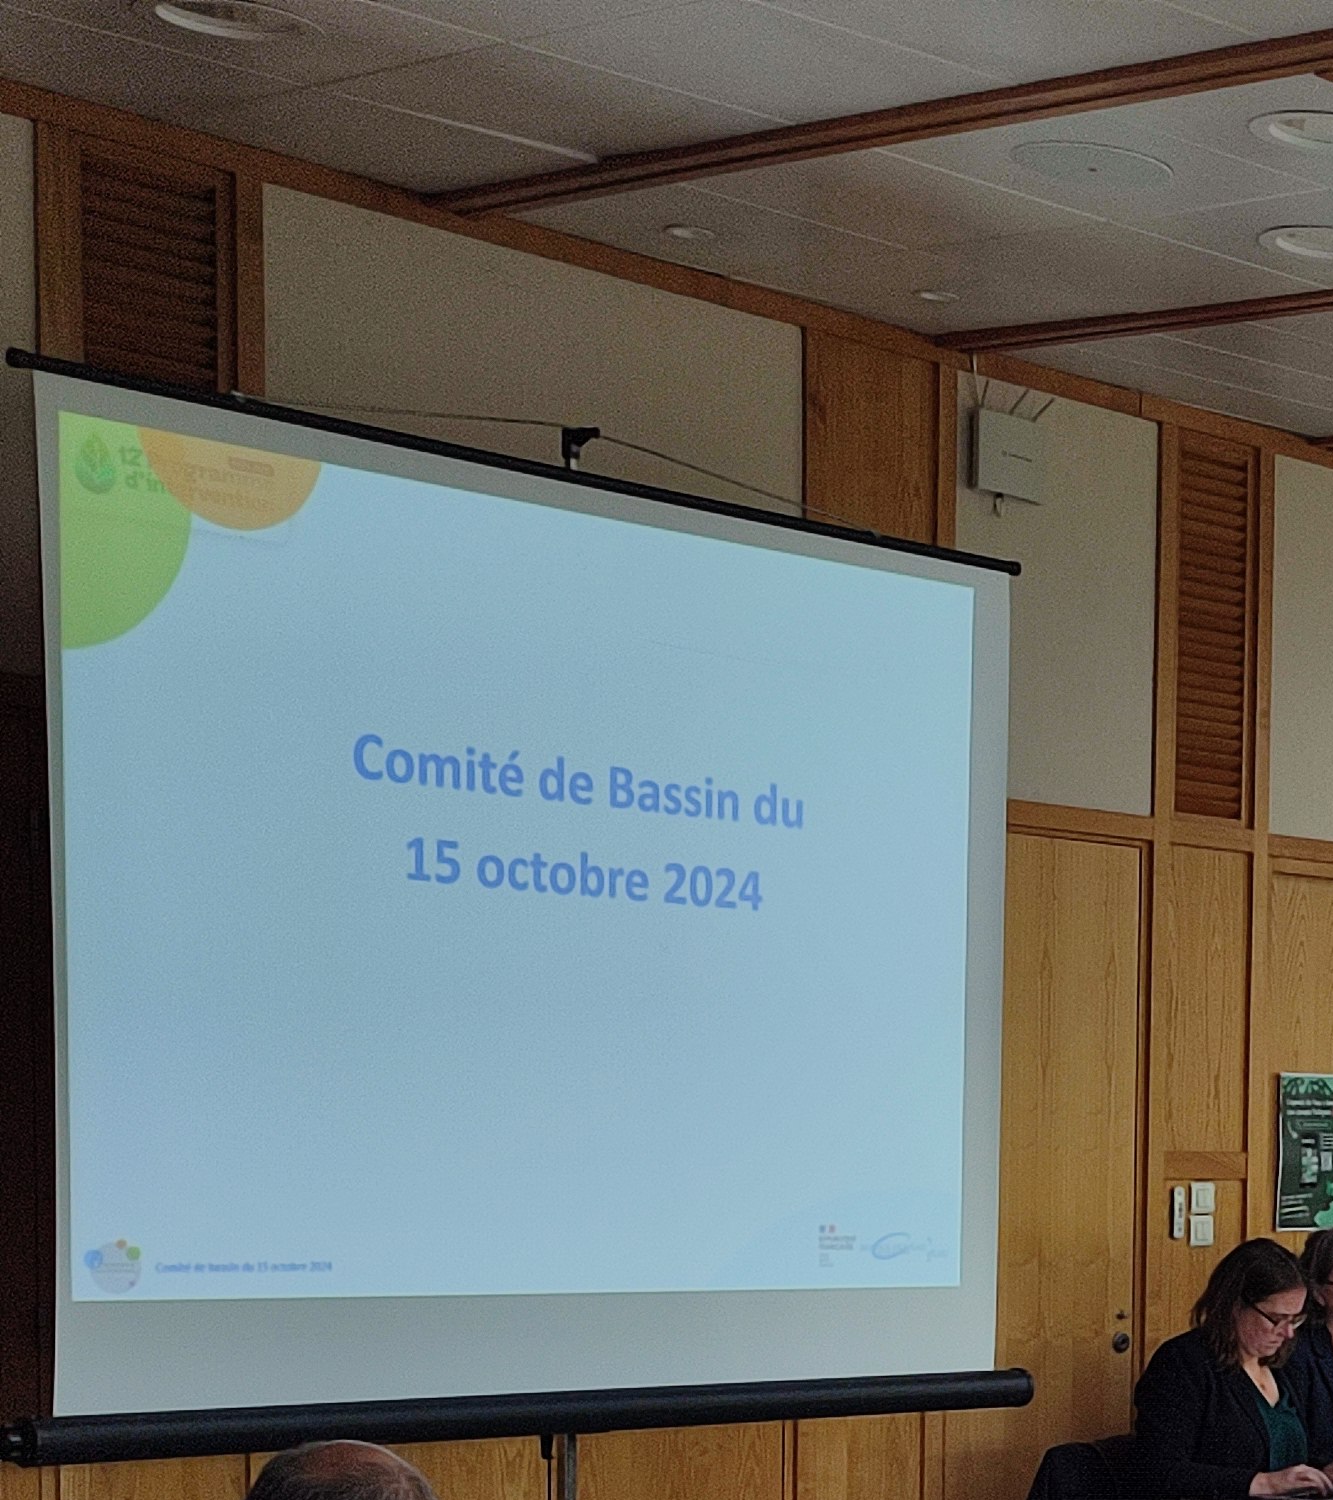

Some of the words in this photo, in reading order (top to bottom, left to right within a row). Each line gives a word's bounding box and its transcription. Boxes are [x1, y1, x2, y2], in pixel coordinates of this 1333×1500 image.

[353, 733, 524, 798] Comité
[538, 756, 594, 805] de
[609, 766, 739, 822] Bassin
[753, 783, 804, 829] du
[406, 837, 461, 884] 15
[476, 851, 650, 901] octobre
[663, 862, 763, 911] 2024
